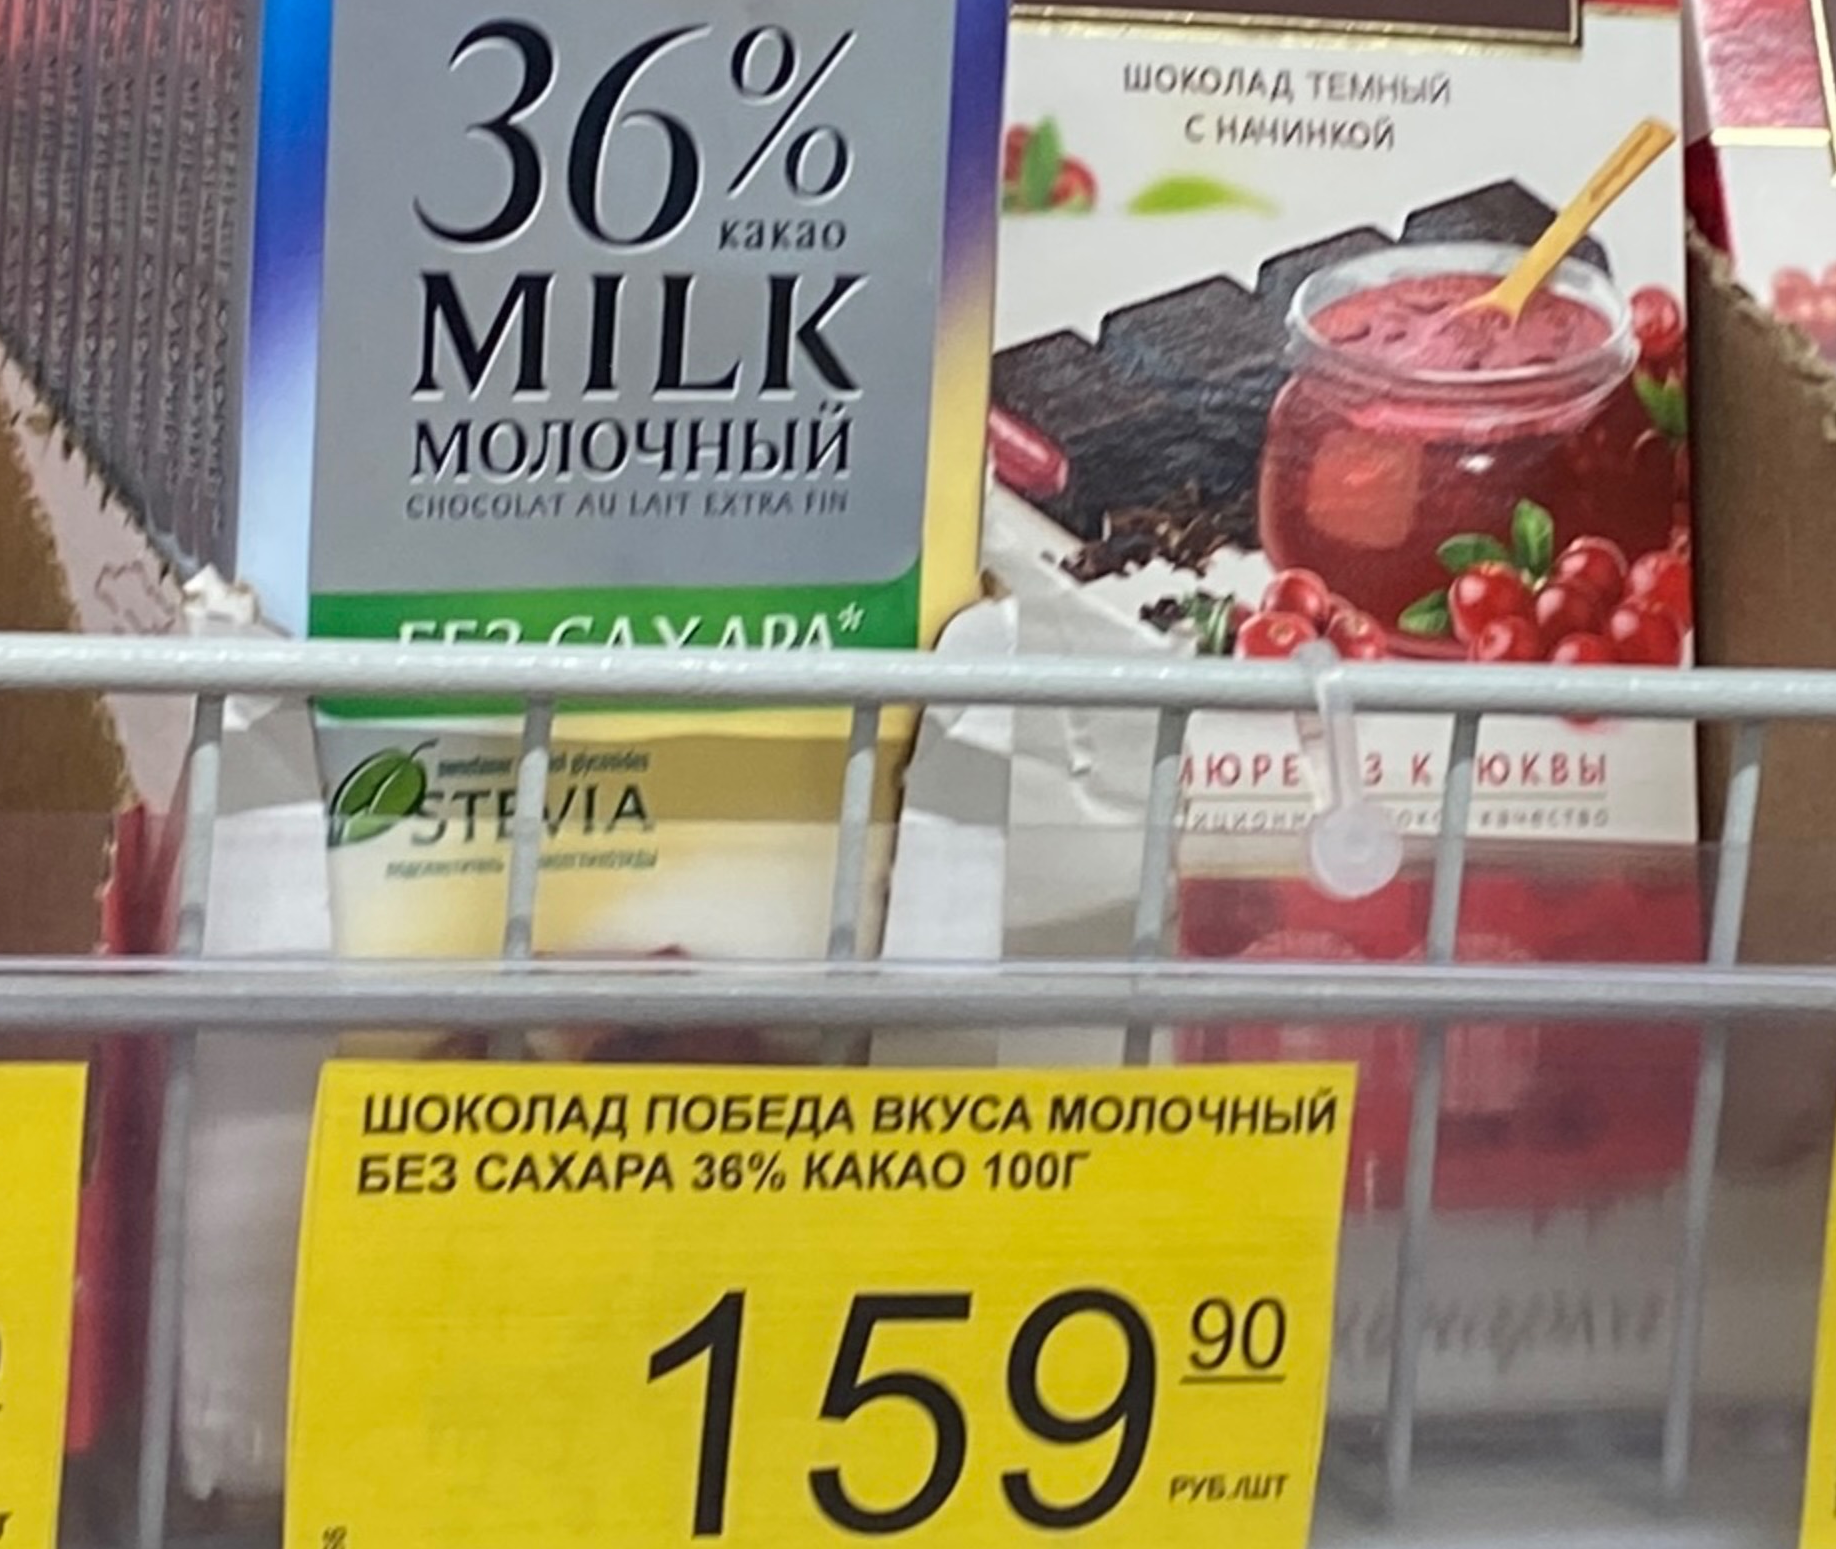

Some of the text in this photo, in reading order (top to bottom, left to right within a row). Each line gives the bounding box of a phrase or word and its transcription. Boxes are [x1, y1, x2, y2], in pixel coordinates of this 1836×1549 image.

[1123, 62, 1453, 106] ШОКОЛАД ТЕМНЫЙ
[412, 18, 859, 252] 36%
[1184, 112, 1396, 152] С НАЧИНКОЙ
[718, 220, 848, 252] какао
[411, 271, 871, 400] MILK
[408, 402, 855, 484] МОЛОЧНЫЙ
[406, 490, 850, 521] CHOCOLAT AU LAIT EXTRA FIN
[1411, 752, 1607, 787] КЮКВЫ
[363, 1086, 1339, 1142] ШОКОЛАД ПОБЕДА ВКУСА МОЛОЧНЫЙ
[357, 1151, 1092, 1195] БЕЗ САХАРА 36% КАКАО 100Г
[1188, 1296, 1288, 1371] 90
[646, 1286, 1158, 1539] 159
[1168, 1474, 1287, 1502] РУБ./ШТ
